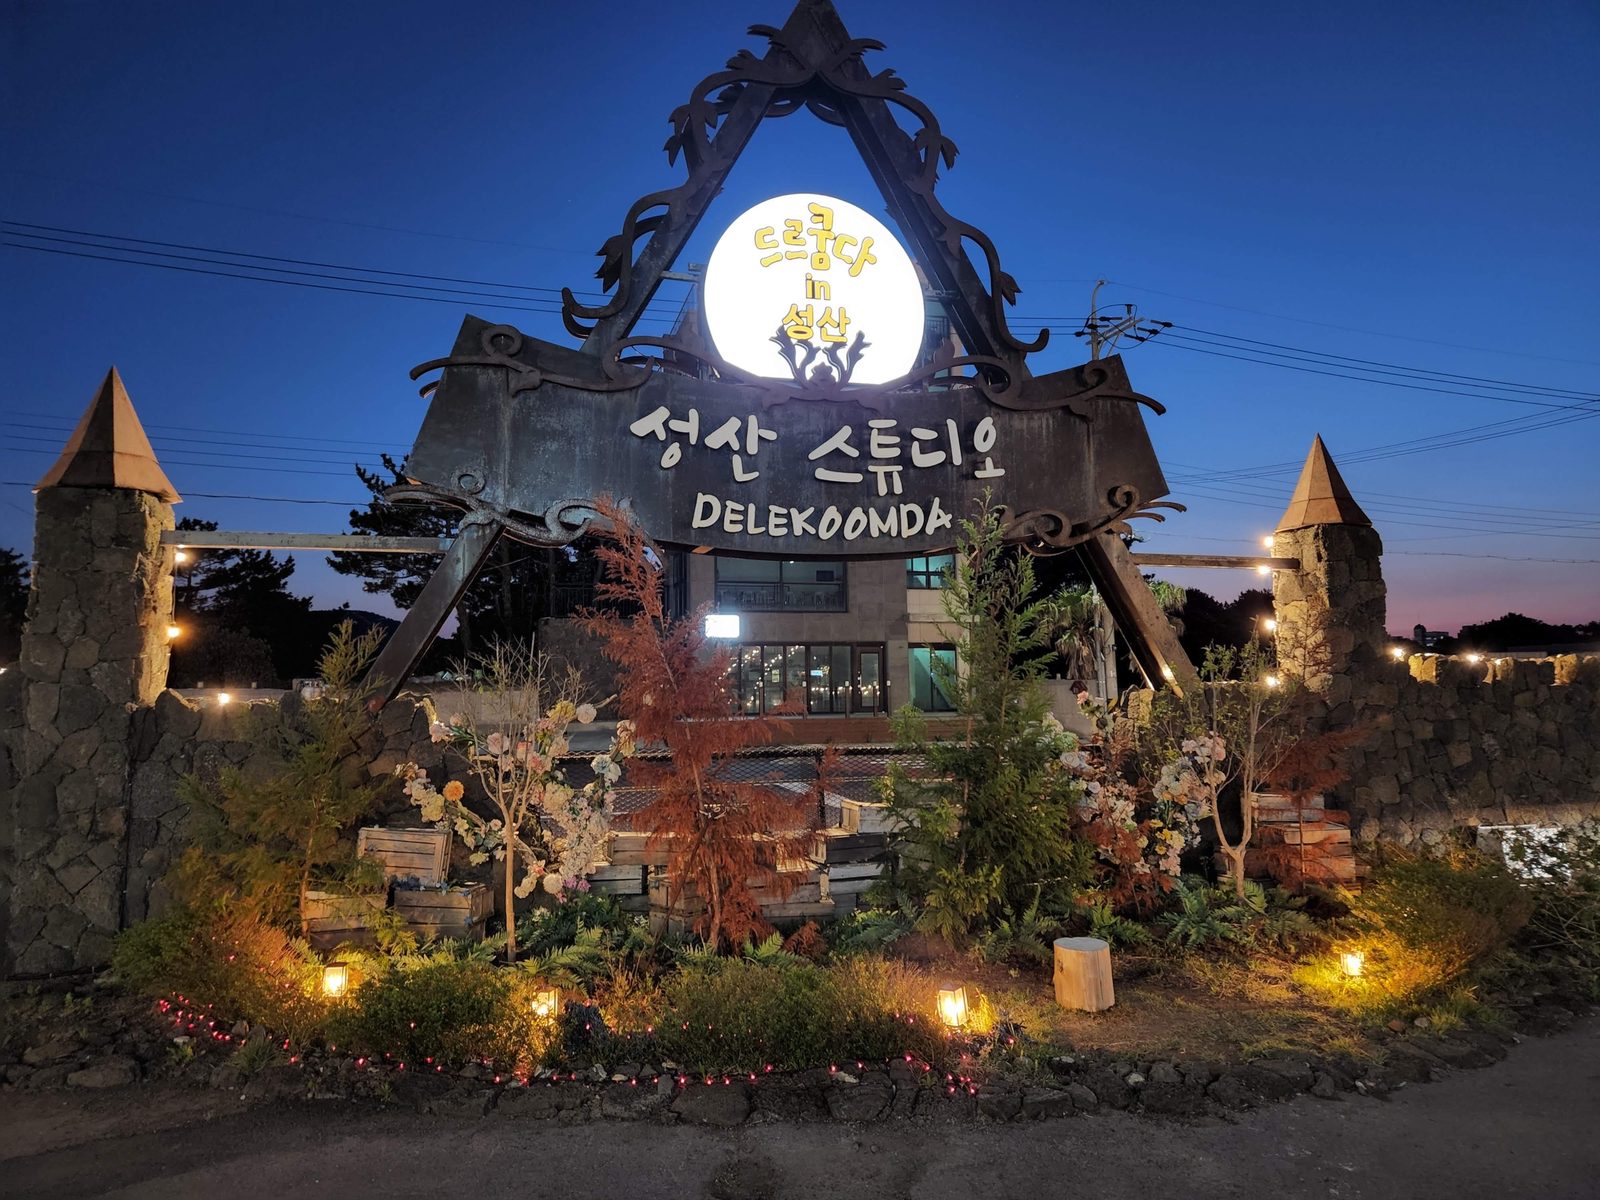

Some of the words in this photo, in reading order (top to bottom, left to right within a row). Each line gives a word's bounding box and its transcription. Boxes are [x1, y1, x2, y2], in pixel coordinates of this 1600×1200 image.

[754, 202, 877, 277] 드르쿰다
[805, 273, 831, 300] in
[782, 303, 851, 343] 성산
[629, 406, 777, 482] 성산
[808, 416, 1005, 496] 스튜디오
[692, 492, 953, 540] DELEKOOMDA
